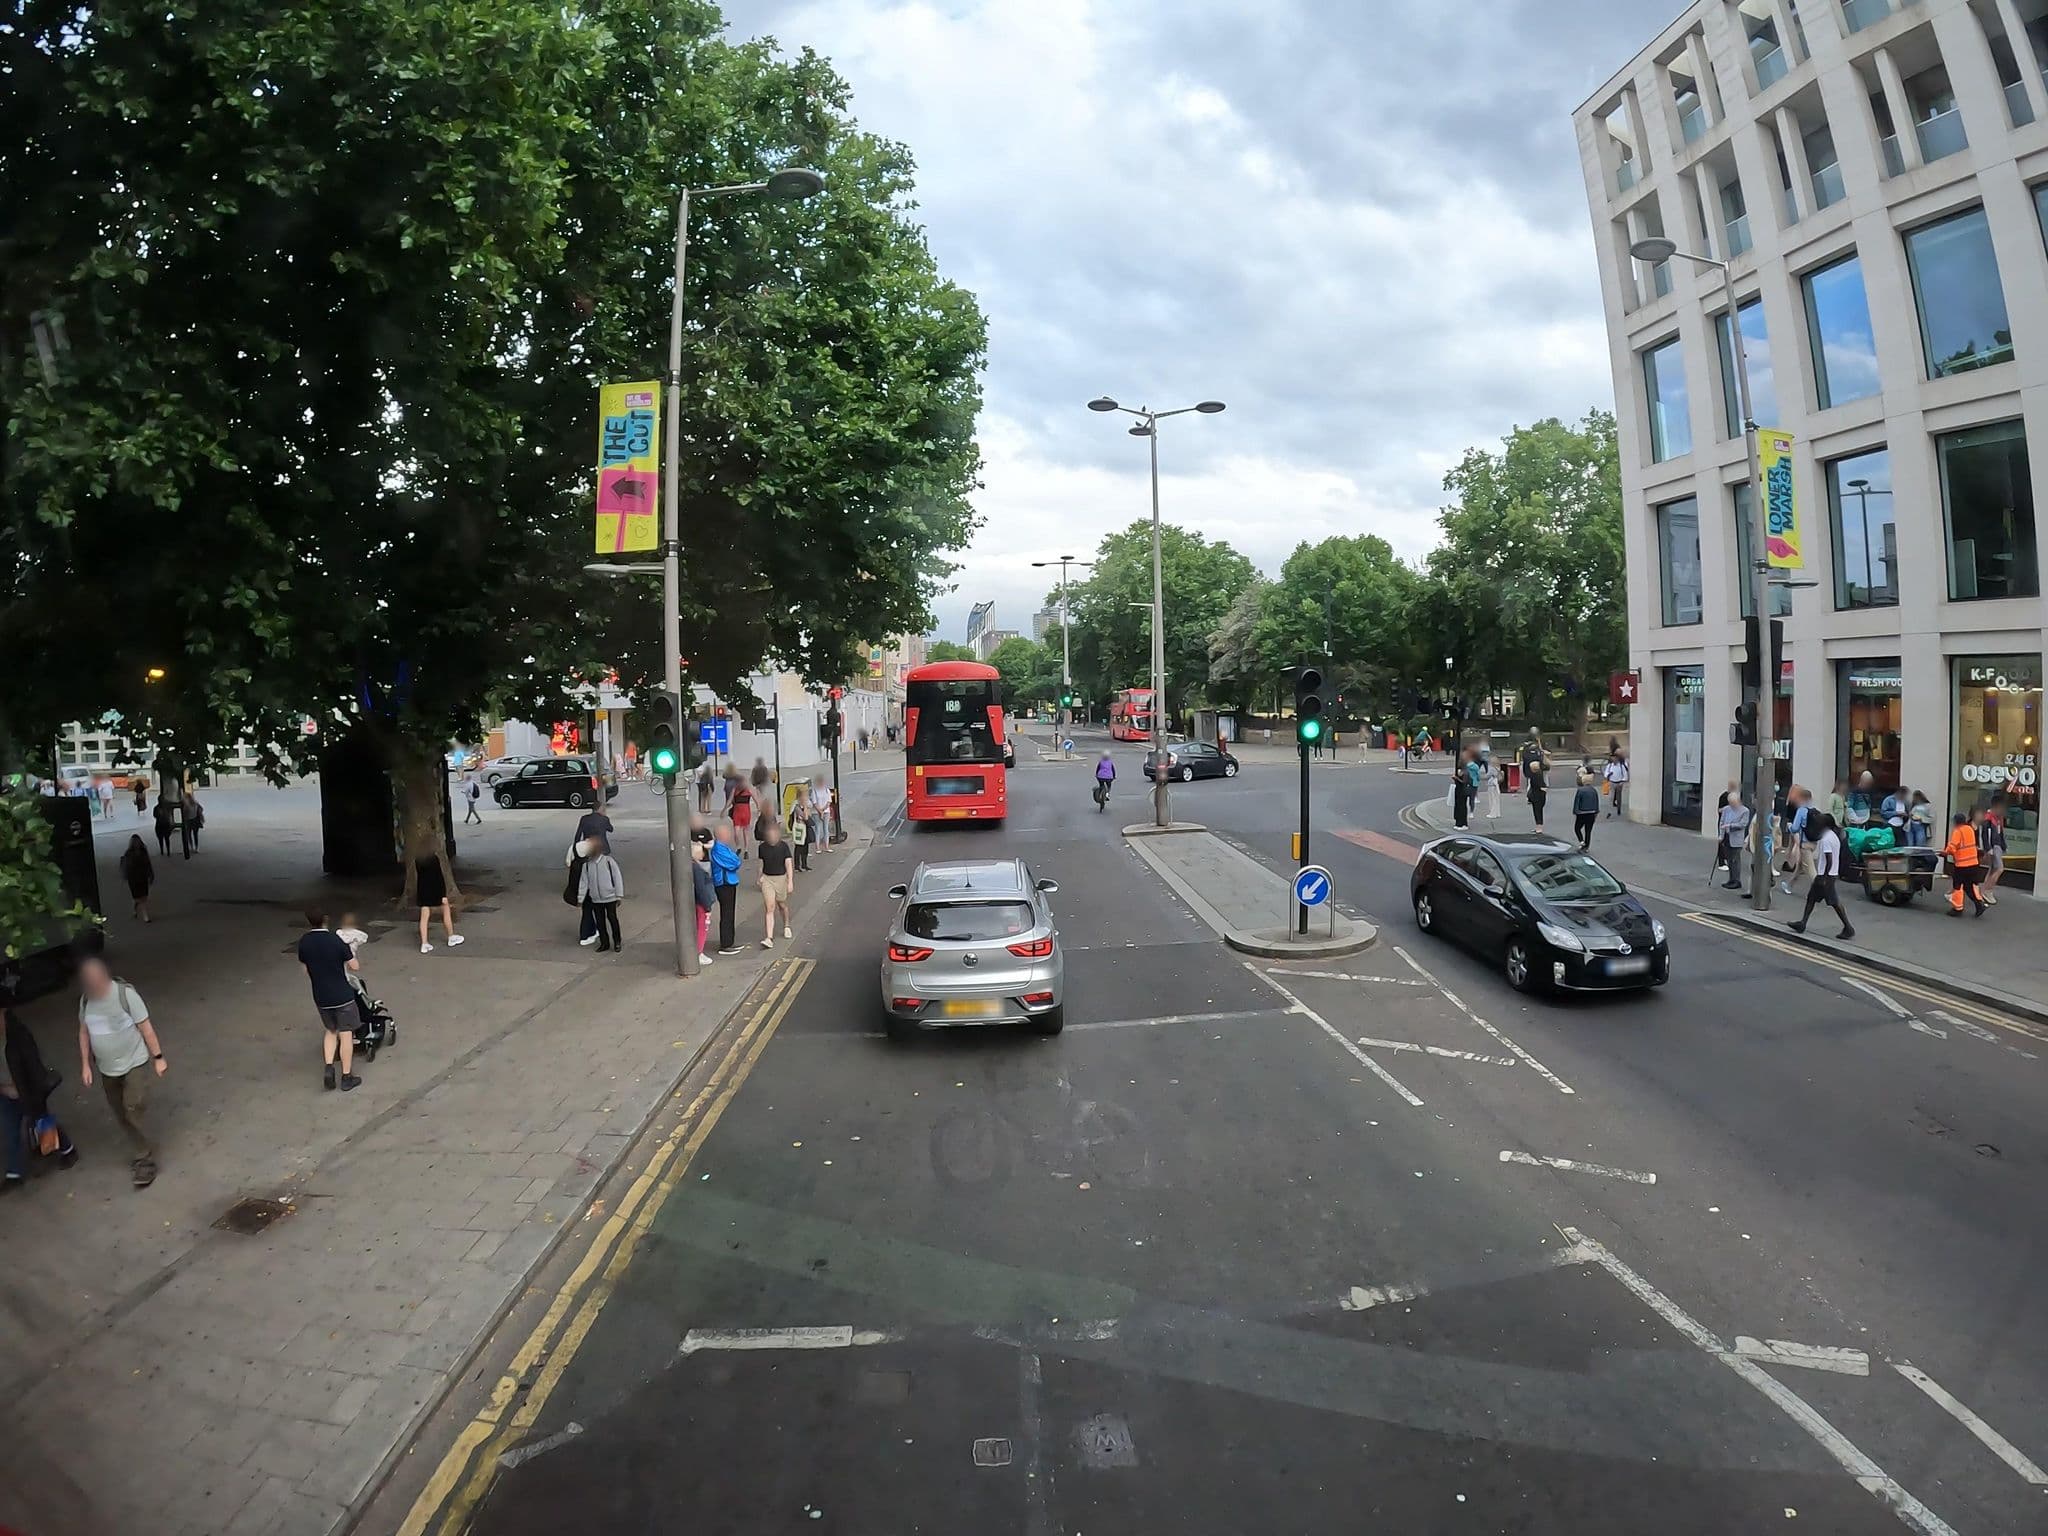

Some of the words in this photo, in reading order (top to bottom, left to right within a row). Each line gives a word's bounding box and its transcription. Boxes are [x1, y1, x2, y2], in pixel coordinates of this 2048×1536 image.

[604, 419, 627, 464] THE
[628, 410, 653, 453] CUT
[1768, 469, 1782, 534] LOWER
[1780, 456, 1793, 530] MARSH
[1683, 685, 1704, 693] COFF
[1856, 678, 1884, 687] FRESH
[1886, 678, 1903, 687] FOO
